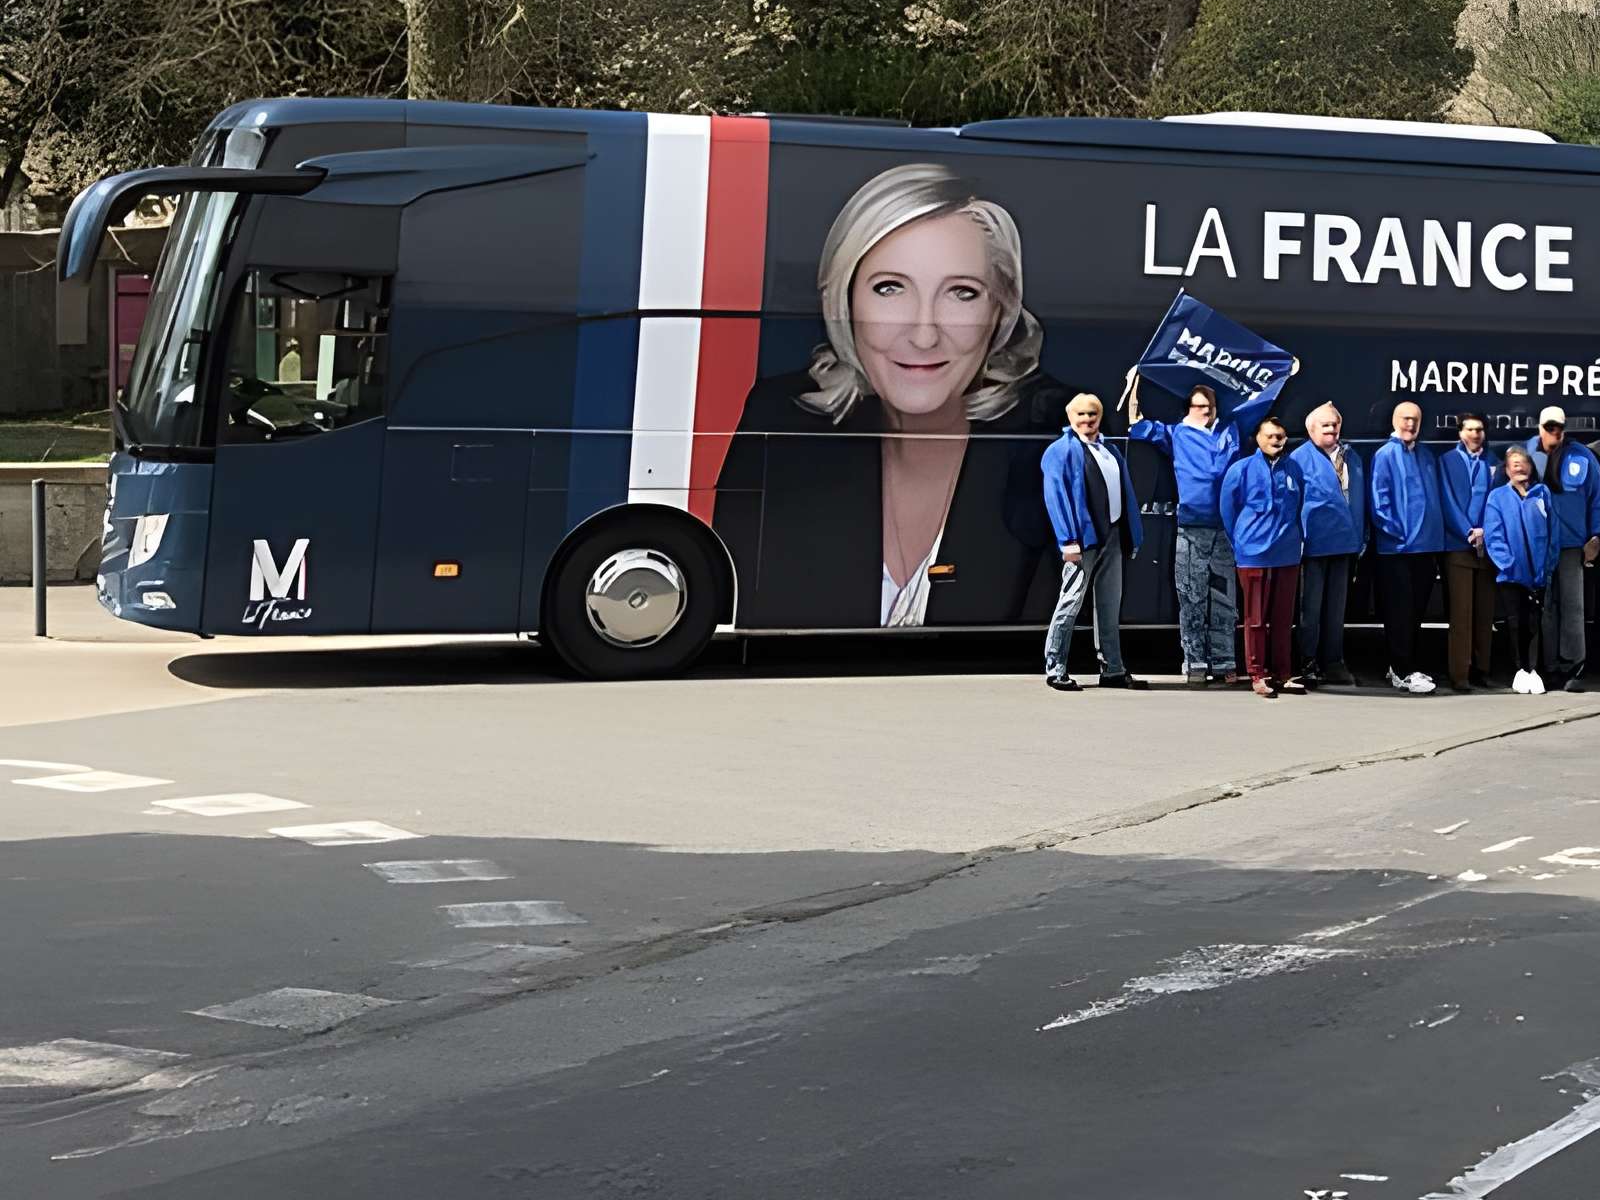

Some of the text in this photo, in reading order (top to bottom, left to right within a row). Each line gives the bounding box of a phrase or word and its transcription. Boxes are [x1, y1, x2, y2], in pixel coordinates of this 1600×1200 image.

[1143, 203, 1237, 278] LA
[1263, 211, 1574, 292] FRANCE
[1391, 359, 1529, 395] MARINE
[249, 538, 310, 601] M
